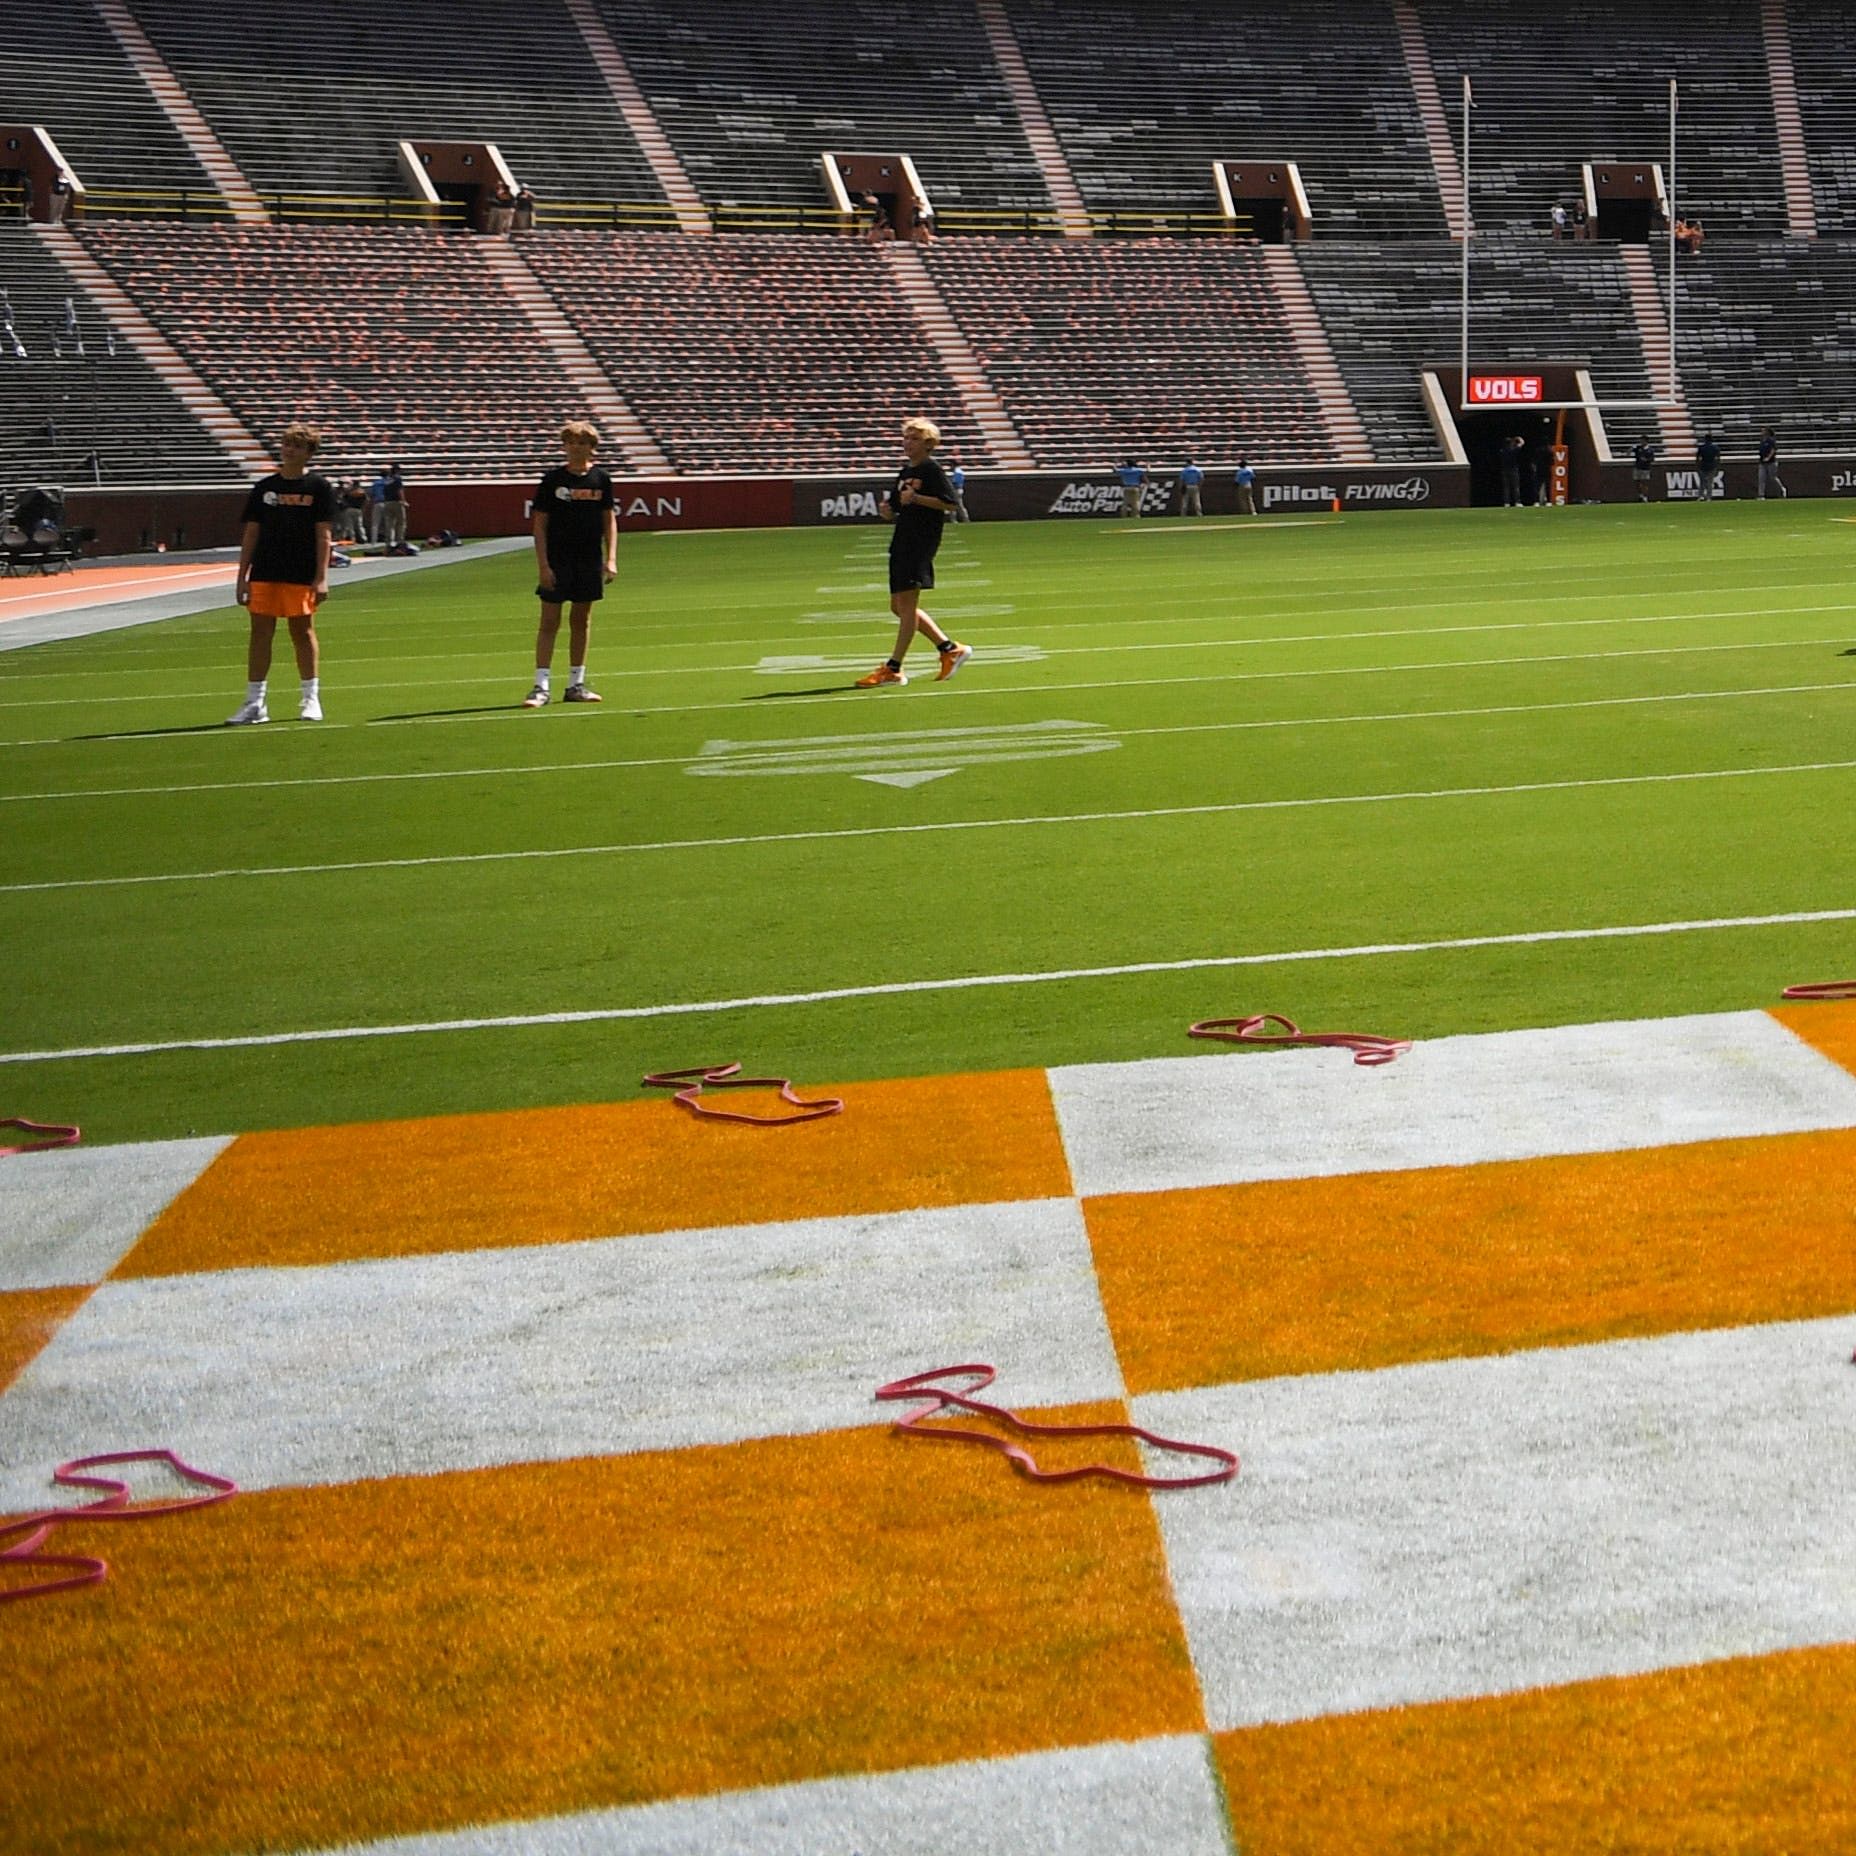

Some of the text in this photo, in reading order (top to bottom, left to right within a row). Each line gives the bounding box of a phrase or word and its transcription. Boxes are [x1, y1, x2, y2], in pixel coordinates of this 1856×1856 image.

[1474, 379, 1537, 400] VOLS
[1556, 451, 1566, 506] VOLS
[821, 492, 879, 518] PAPA
[1048, 499, 1092, 513] Auto
[1264, 484, 1406, 508] Pilot FLYING
